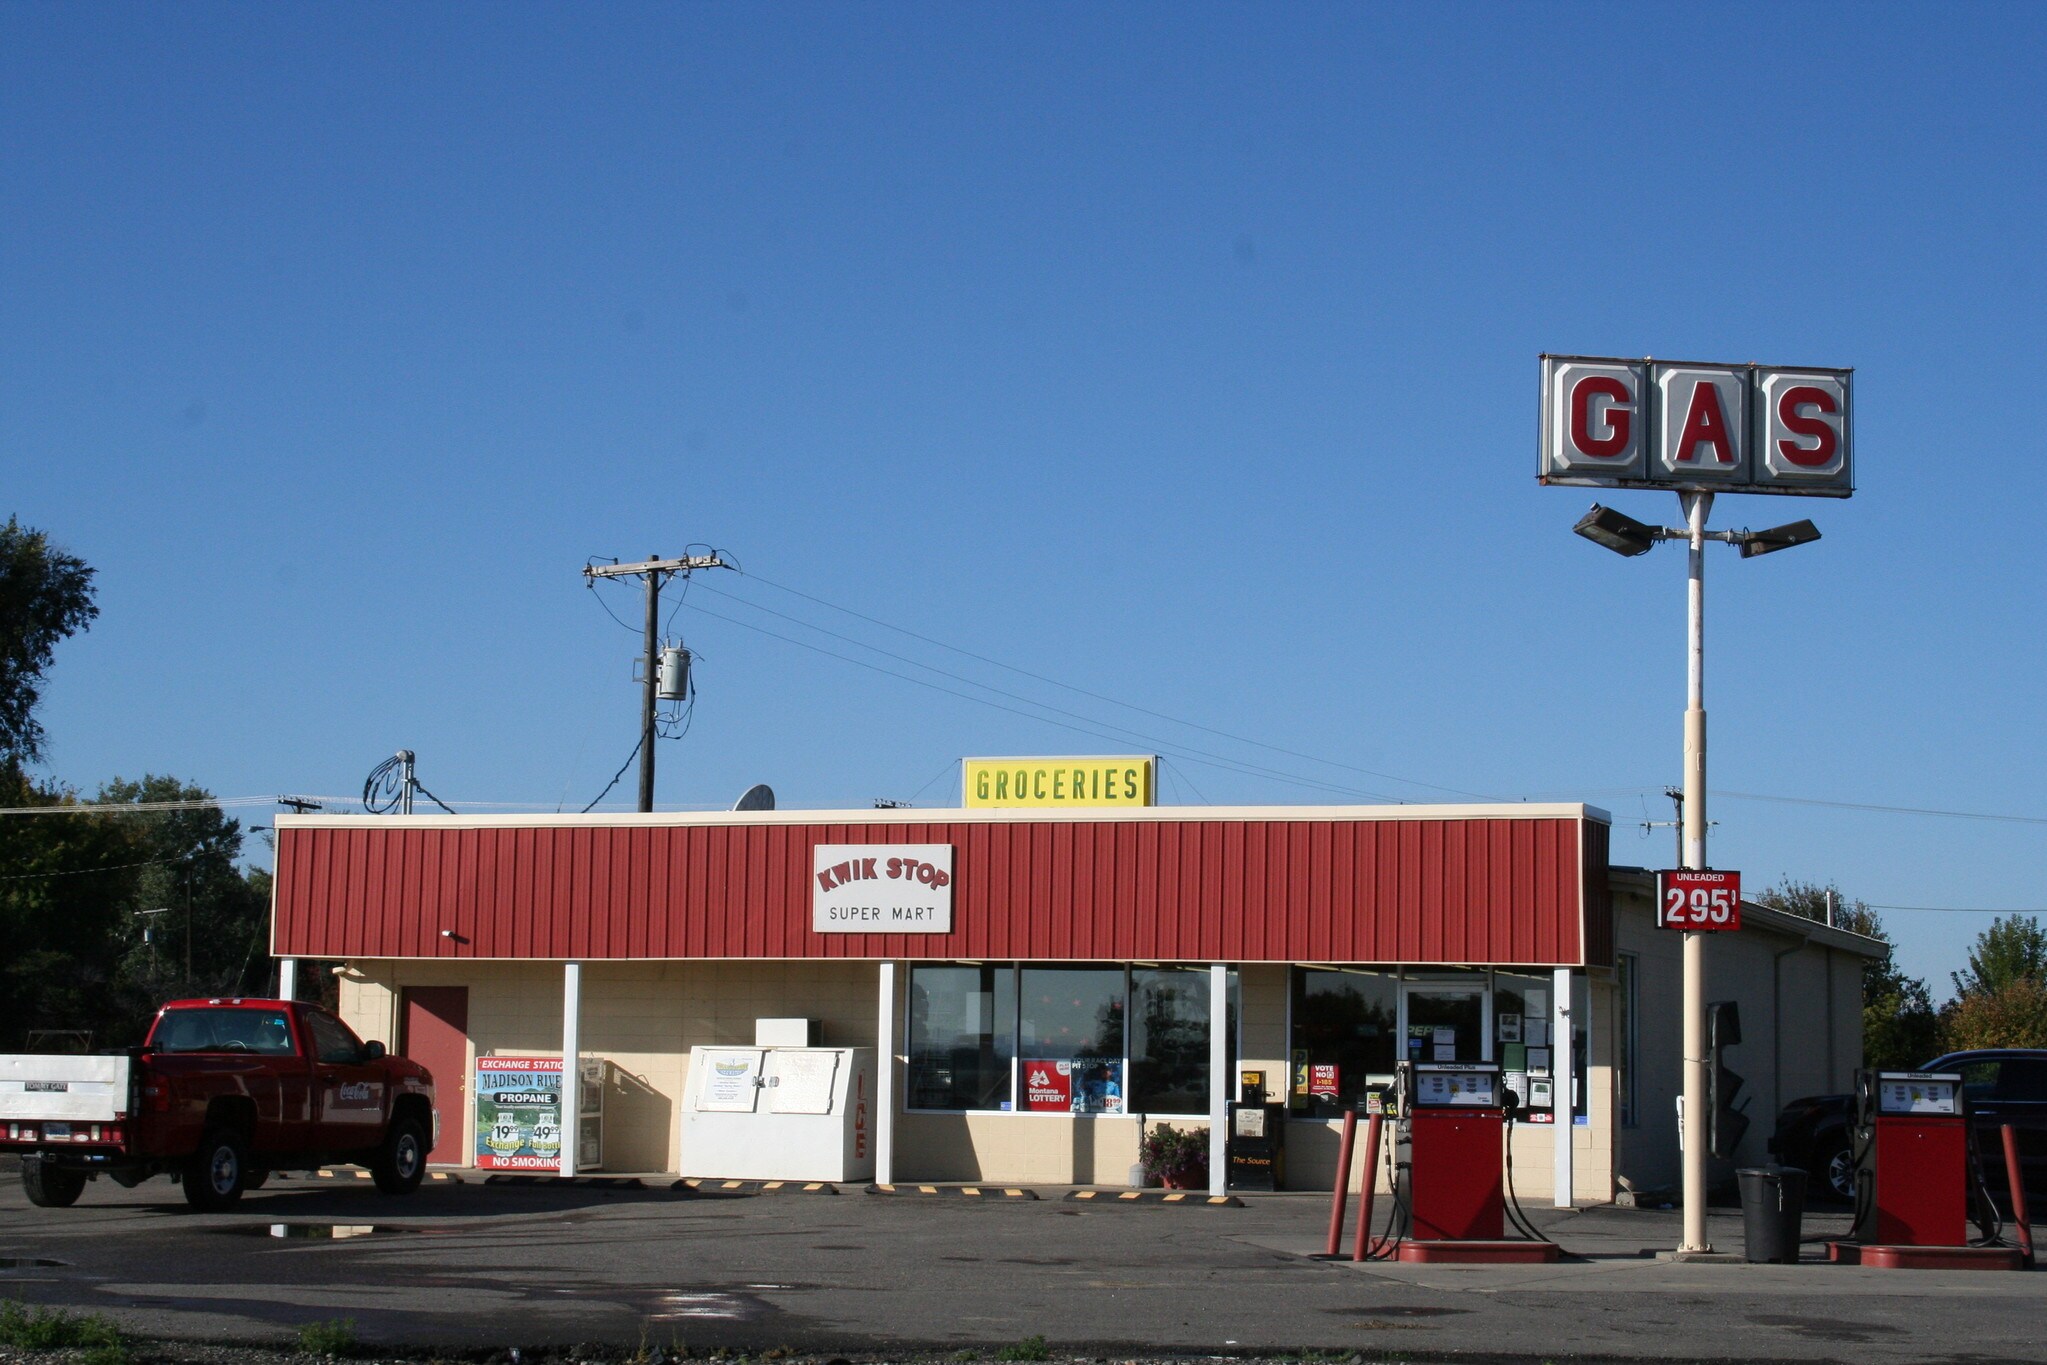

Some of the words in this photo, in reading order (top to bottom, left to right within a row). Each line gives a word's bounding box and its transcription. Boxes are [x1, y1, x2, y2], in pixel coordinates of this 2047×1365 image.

[1569, 375, 1838, 467] GAS
[976, 768, 1138, 800] GROCERIES
[816, 857, 879, 893] KWIK
[885, 857, 950, 891] STOP
[1676, 873, 1725, 882] UNLEADED
[829, 907, 881, 920] SUPER
[892, 907, 935, 920] MART
[482, 1060, 530, 1069] EXCHANGE
[533, 1060, 564, 1069] STATIO
[482, 1074, 533, 1090] MADISON
[536, 1074, 561, 1089] RIVE
[1028, 1087, 1058, 1095] Montana
[500, 1093, 552, 1103] PROPANE
[1029, 1094, 1066, 1103] LOTTERY
[855, 1072, 866, 1158] ICE
[485, 1136, 525, 1150] Exchange
[492, 1157, 510, 1167] NO
[1233, 1156, 1246, 1164] The
[1248, 1157, 1271, 1165] Source
